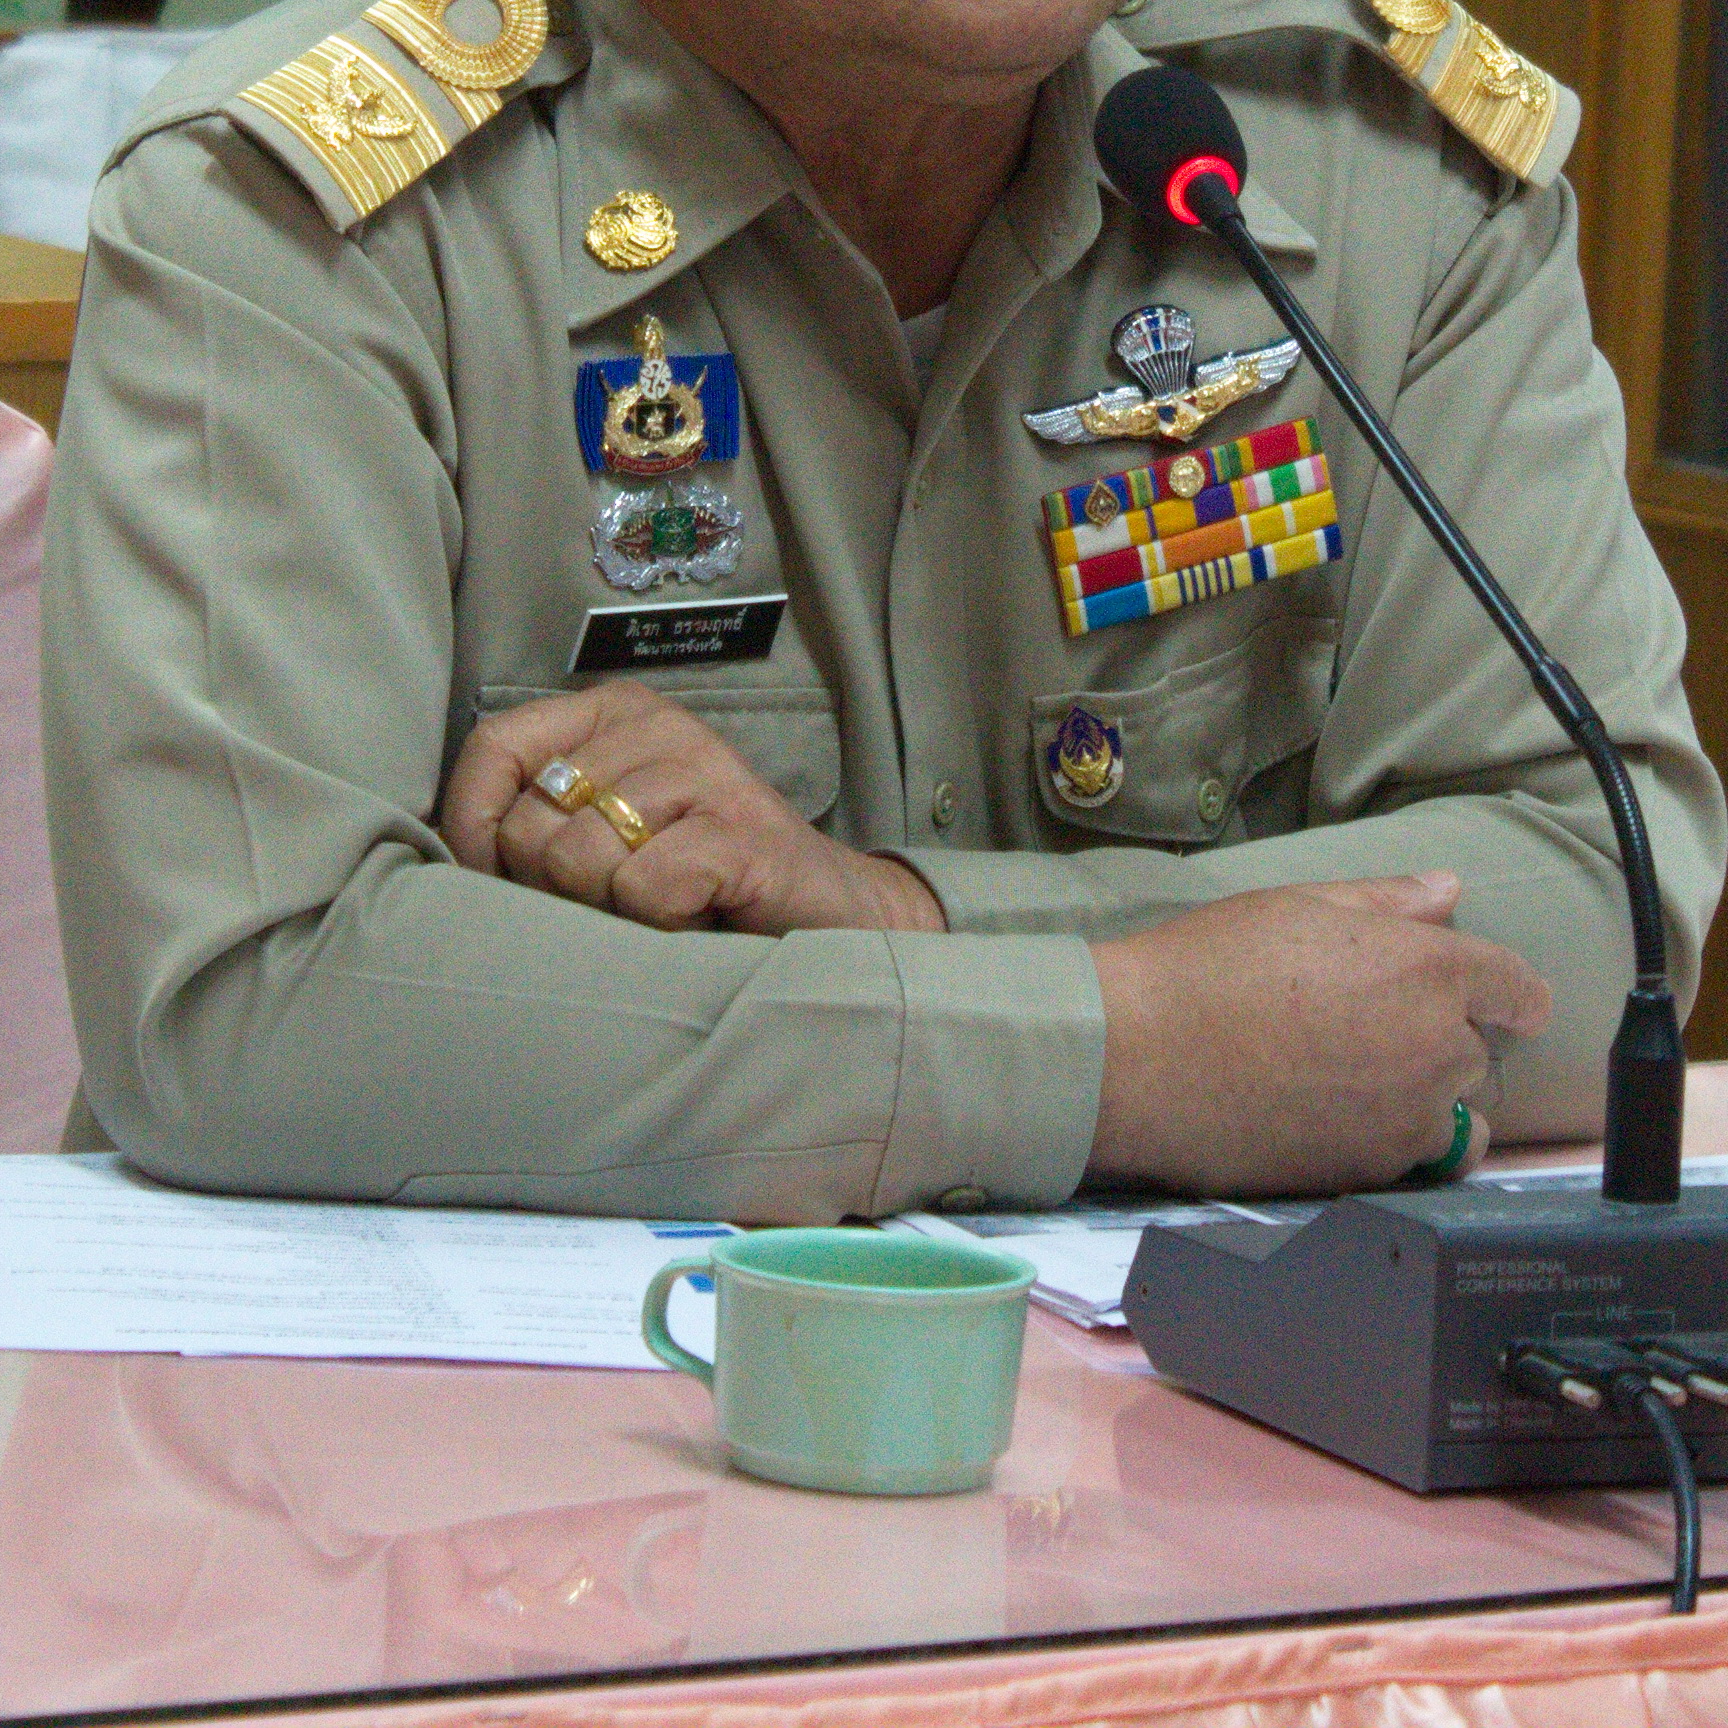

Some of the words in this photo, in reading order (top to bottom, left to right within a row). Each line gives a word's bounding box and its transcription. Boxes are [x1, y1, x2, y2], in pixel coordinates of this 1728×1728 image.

[1456, 1260, 1569, 1276] PROFESSIONAL
[1455, 1277, 1558, 1293] CONFERENCE
[1561, 1275, 1623, 1291] SYSTEM
[1595, 1304, 1634, 1322] LINE
